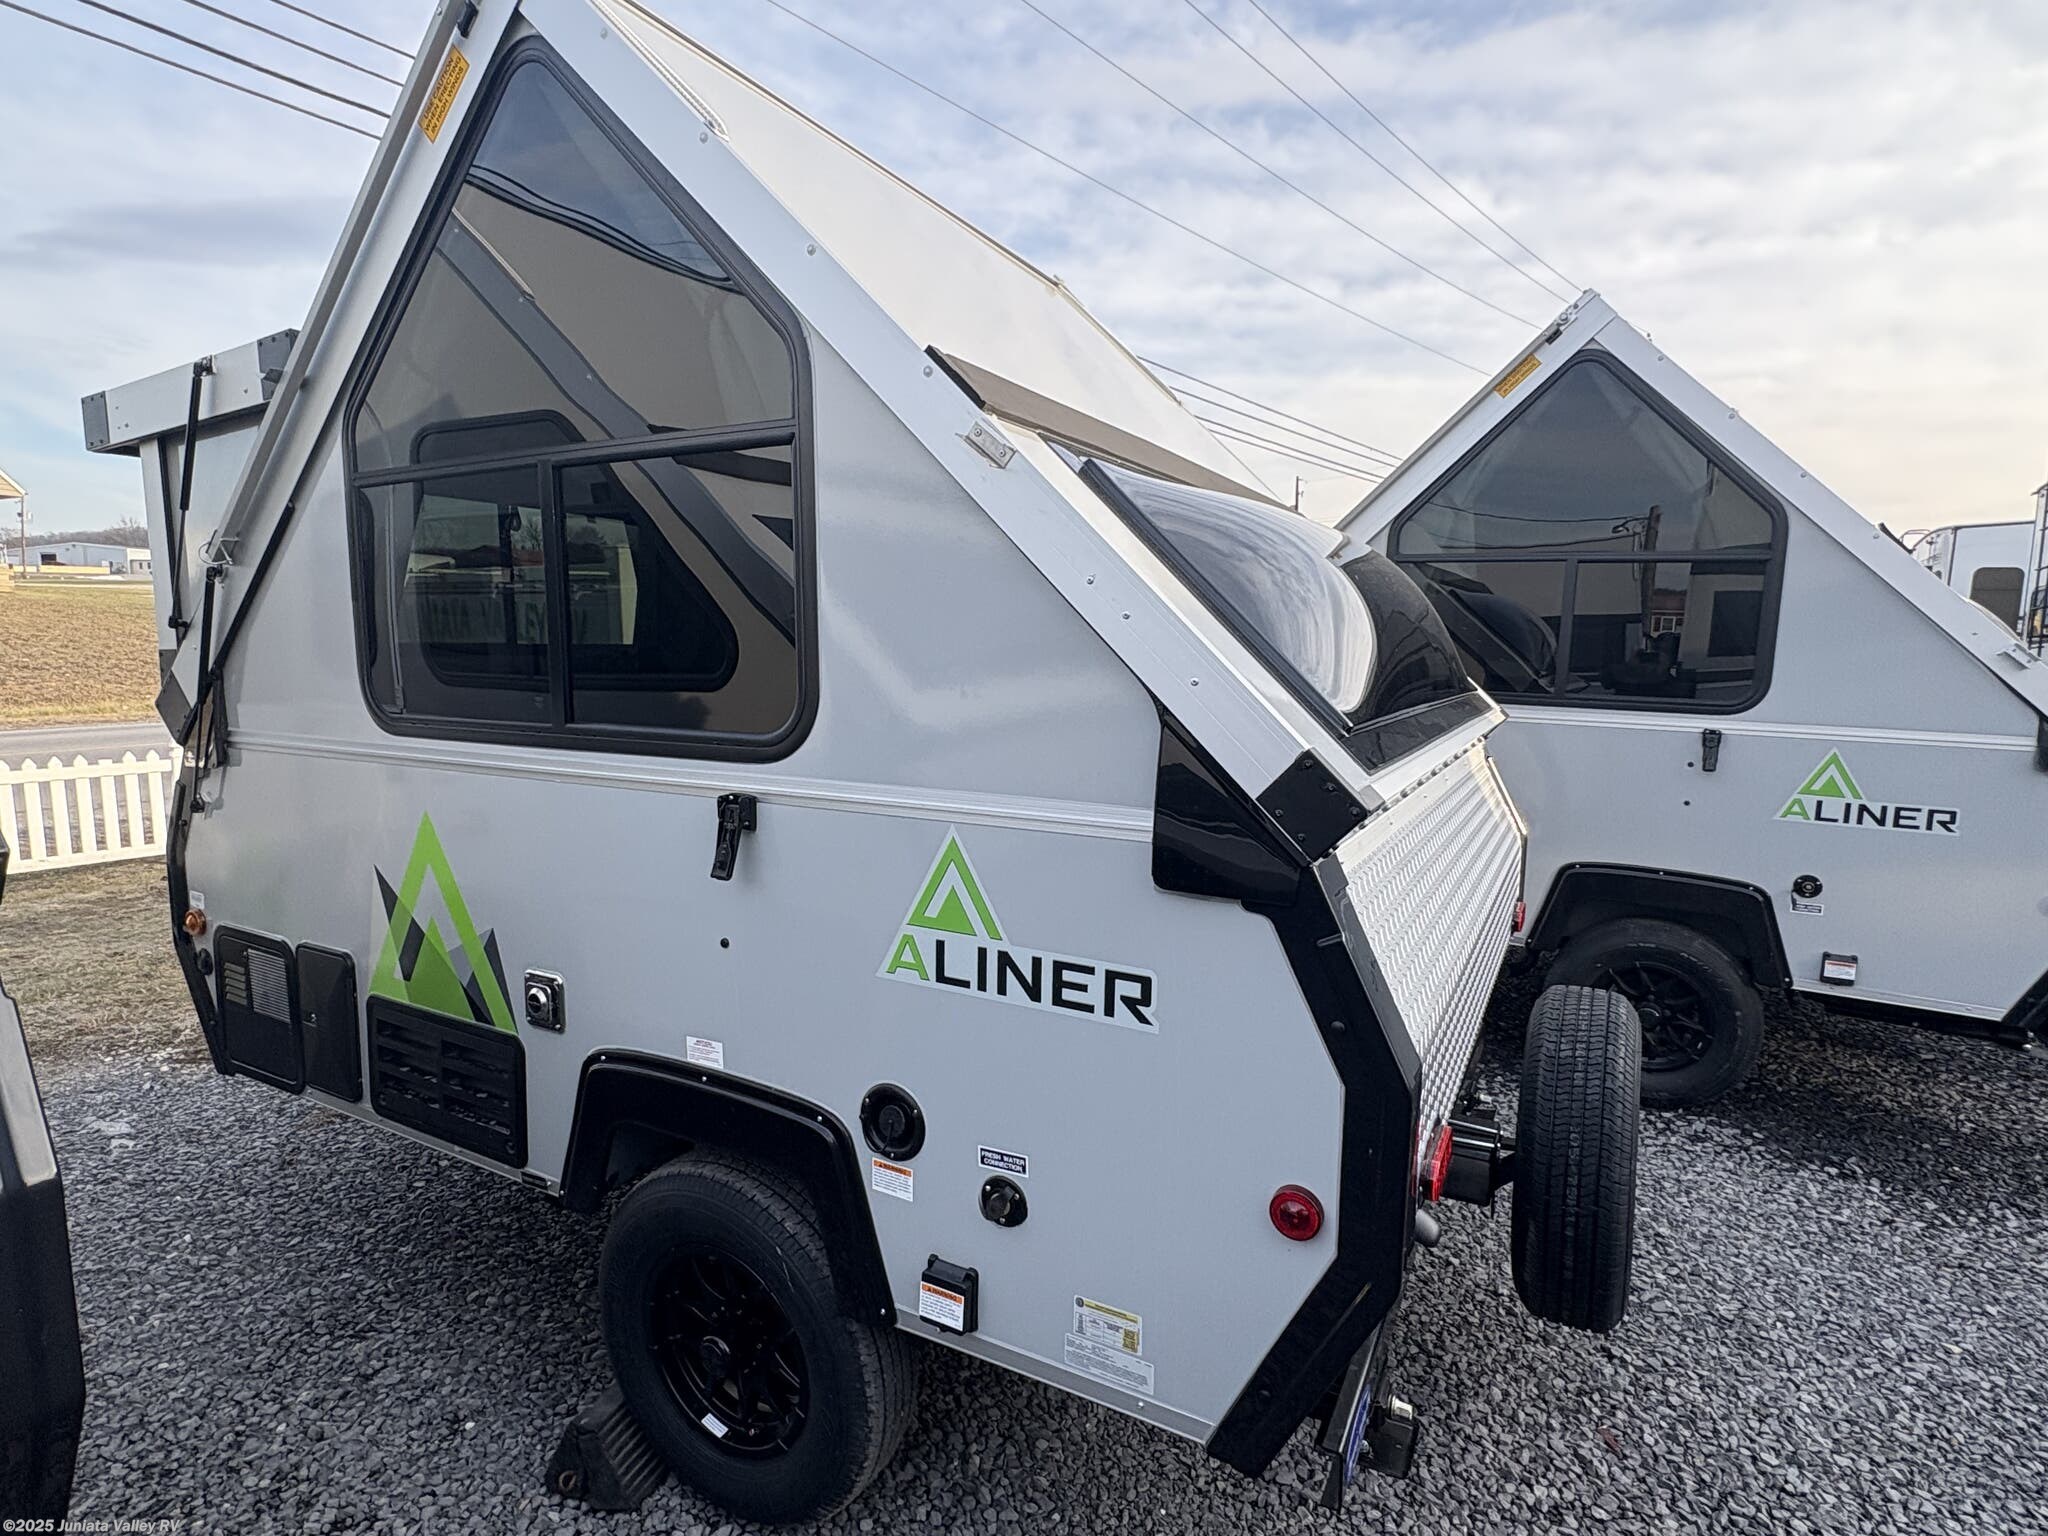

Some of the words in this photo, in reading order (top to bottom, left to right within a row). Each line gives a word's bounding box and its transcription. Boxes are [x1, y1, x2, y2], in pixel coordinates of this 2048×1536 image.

[425, 104, 440, 131] WHEN
[438, 56, 462, 103] ERECTING
[433, 58, 454, 99] CAUTION
[436, 98, 449, 122] HIGH
[447, 66, 464, 97] WINDS
[1779, 797, 1957, 833] ALINER
[886, 934, 1154, 1026] ALINER
[982, 1150, 1001, 1160] FRESH
[1003, 1156, 1025, 1166] WATER
[984, 1158, 1023, 1172] CONNECTION
